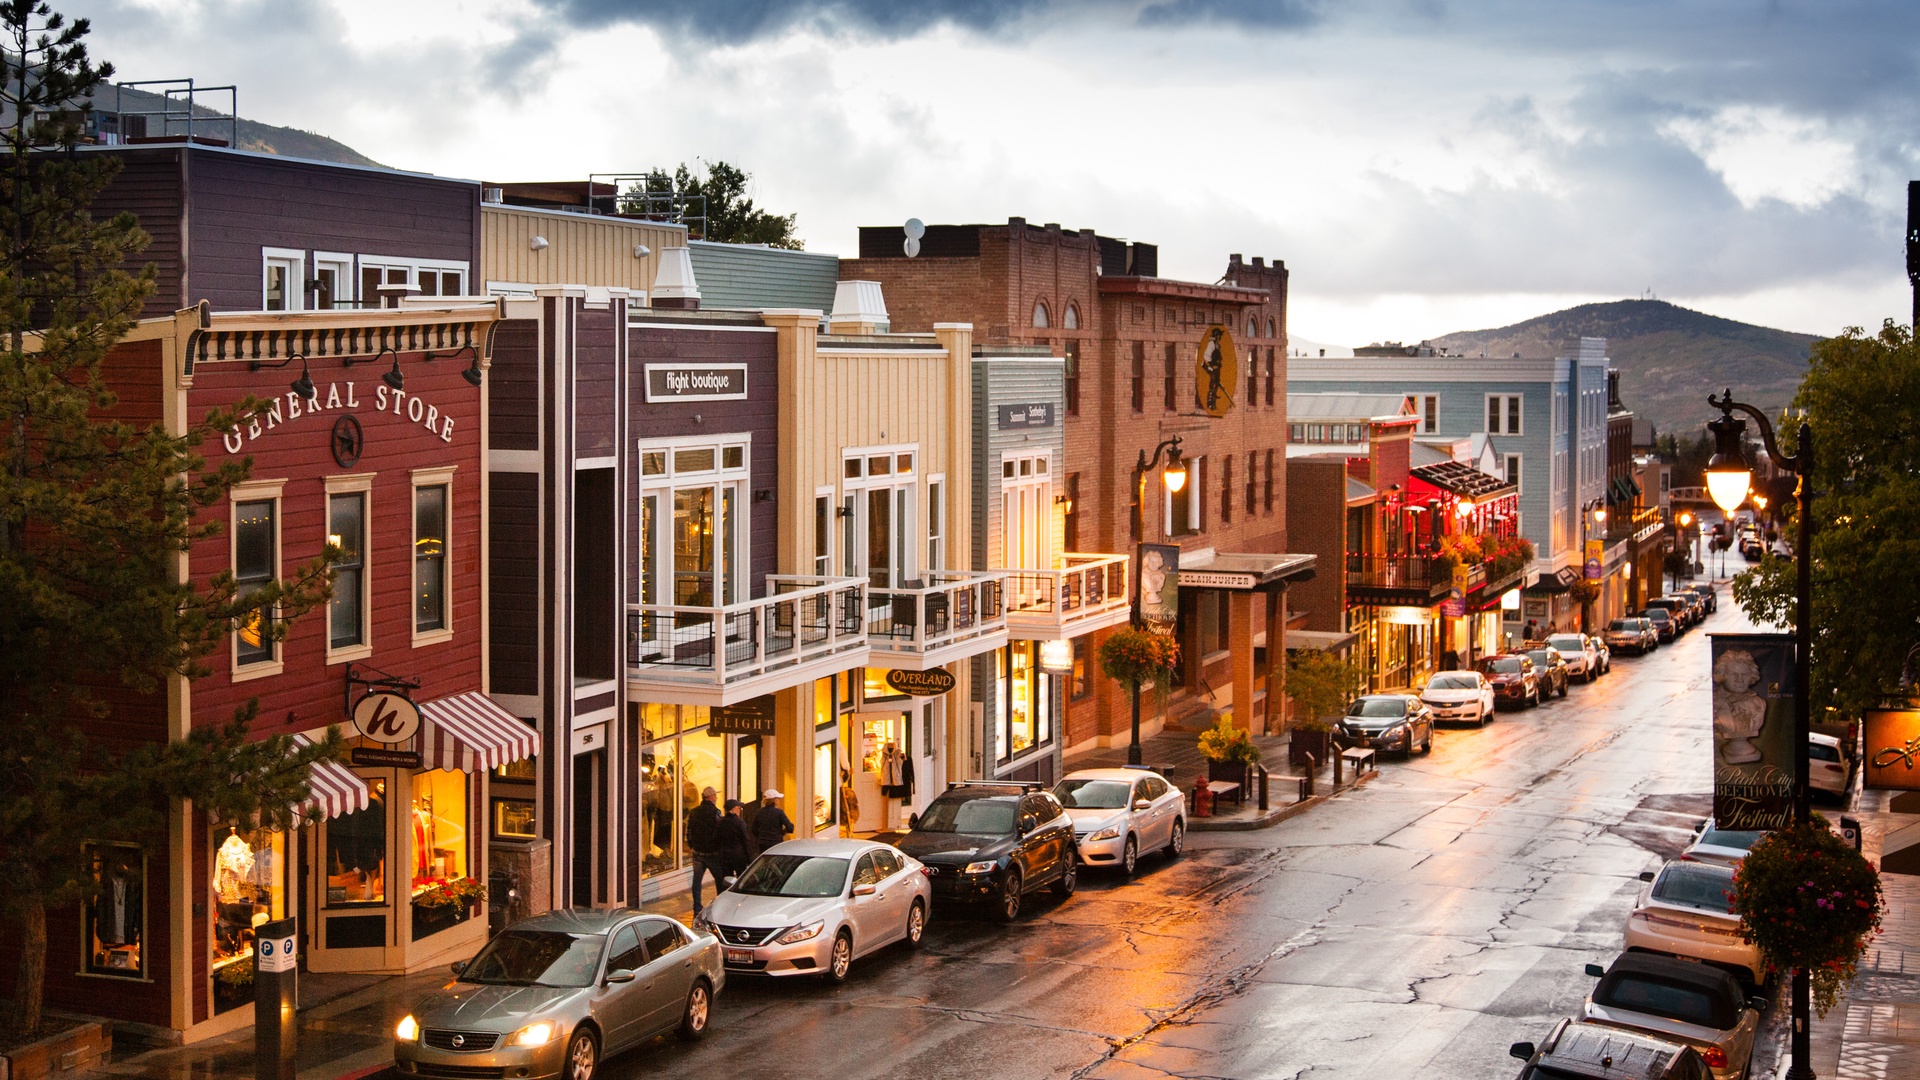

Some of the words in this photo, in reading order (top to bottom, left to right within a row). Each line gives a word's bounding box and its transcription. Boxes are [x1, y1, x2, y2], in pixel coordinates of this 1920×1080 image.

[666, 371, 689, 394] flight
[691, 371, 730, 393] boutique
[223, 381, 359, 454] GENERAL
[375, 384, 455, 443] STORE
[1184, 575, 1249, 585] CLAIMJUMPER
[892, 670, 951, 687] OVERLAND
[366, 696, 406, 737] h
[714, 717, 773, 730] FLIGHT
[1716, 765, 1760, 785] Park
[1760, 765, 1793, 793] City
[1717, 797, 1790, 829] Festival
